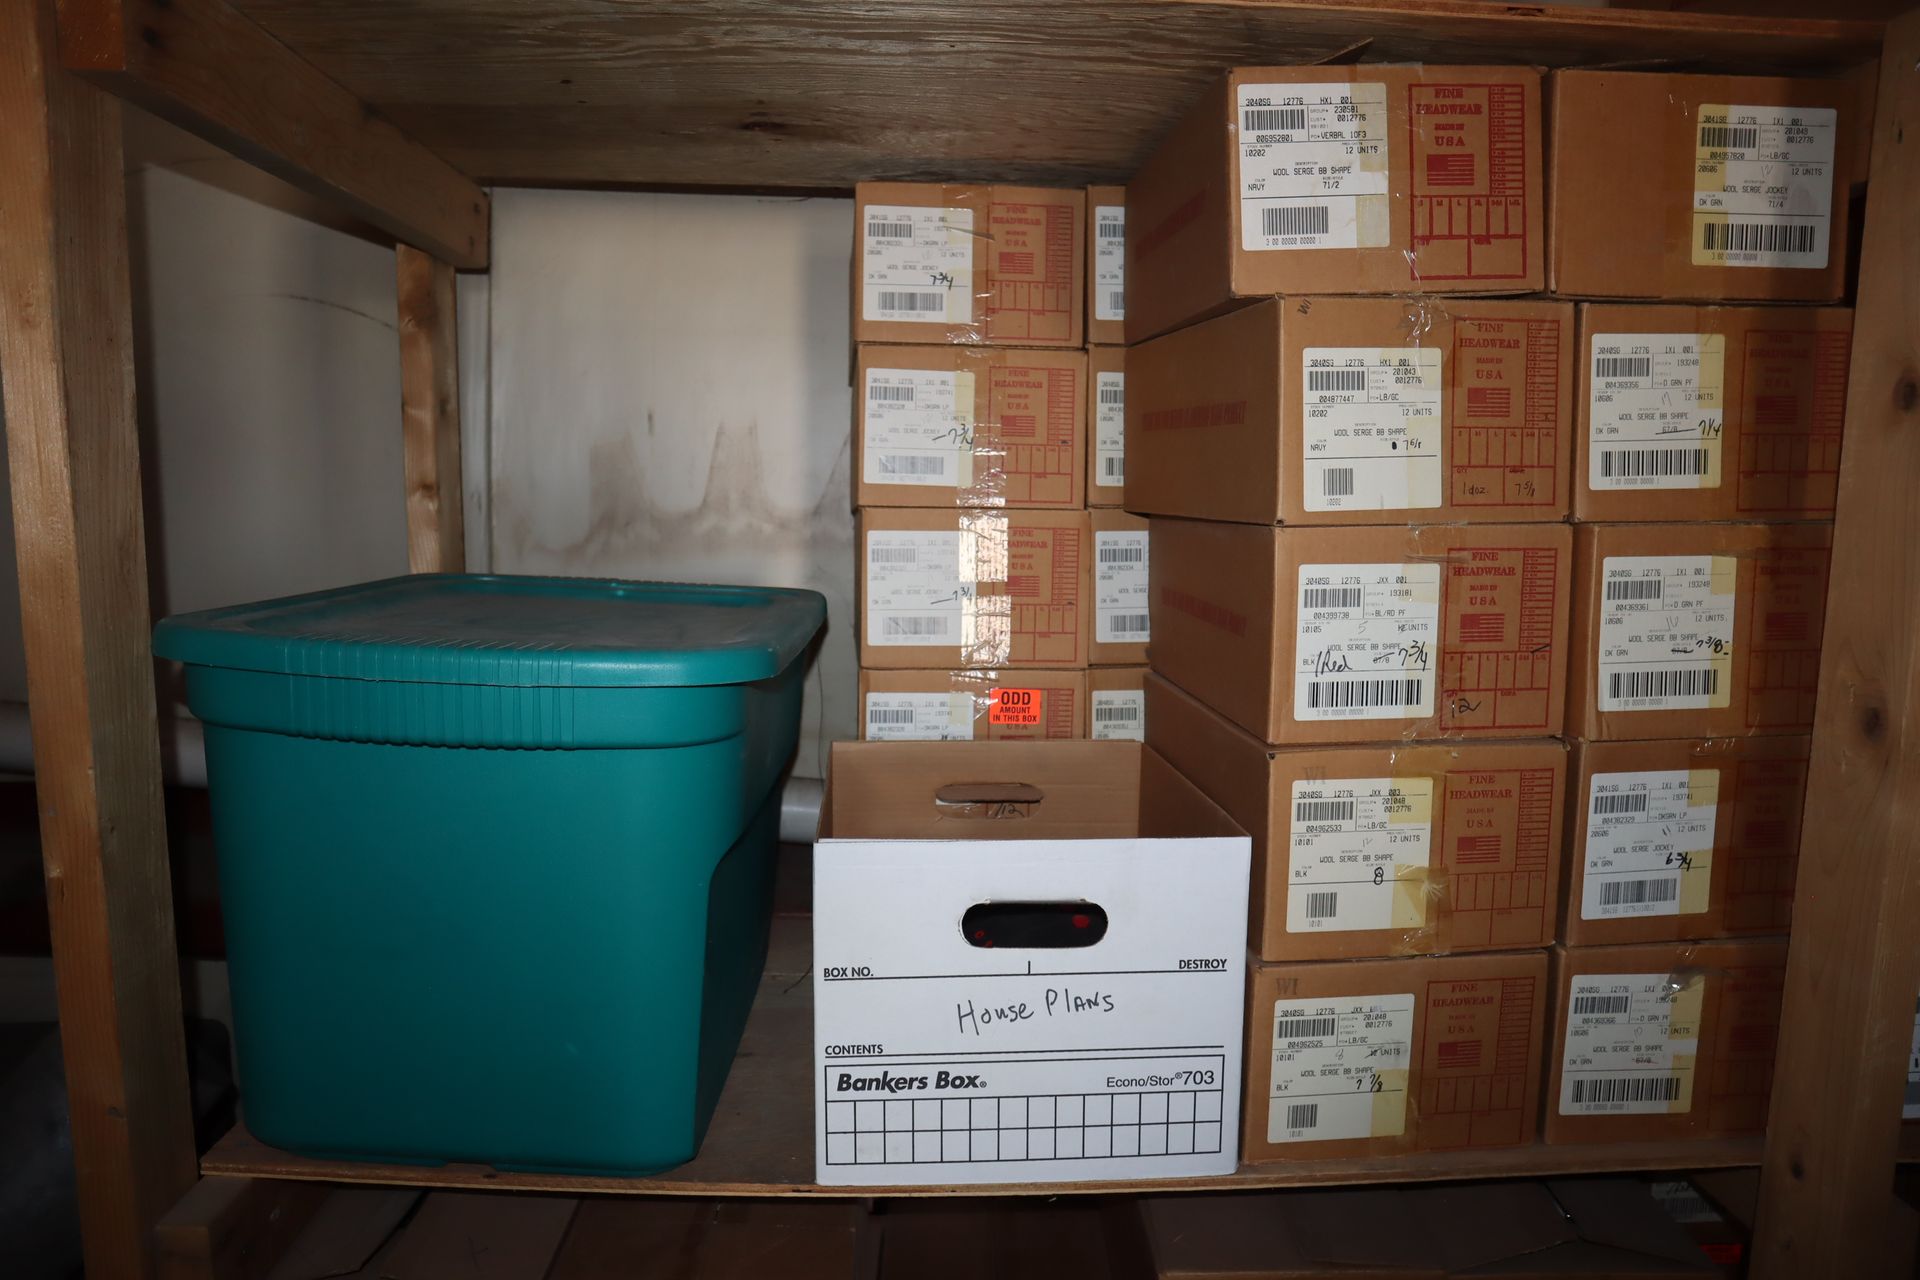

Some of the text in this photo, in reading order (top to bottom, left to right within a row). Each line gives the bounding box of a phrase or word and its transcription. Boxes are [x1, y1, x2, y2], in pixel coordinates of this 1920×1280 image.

[1434, 88, 1464, 99] FINE
[1434, 136, 1465, 147] USA
[1245, 149, 1266, 157] 10202
[1345, 145, 1378, 155] 12 UNITS
[1272, 166, 1352, 176] WOOL SERGE SHAPE
[1791, 168, 1822, 176] 12 UNITS
[1247, 183, 1265, 191] NAVY
[1722, 185, 1738, 193] WOOL
[1742, 185, 1762, 194] SERGE
[1477, 322, 1504, 334] FINE
[1459, 338, 1520, 350] HEADWEAR
[1398, 358, 1410, 367] 001
[1475, 369, 1503, 380] USA
[1684, 392, 1714, 401] 12 UNITS
[1308, 409, 1328, 418] 10202
[1401, 408, 1432, 417] 12 UNITS
[1618, 411, 1688, 420] WOOL SERGE SHAPE
[1334, 428, 1407, 437] WOOL SERGE SHAPE
[1310, 444, 1327, 452] NAVY
[1471, 551, 1498, 562] FINE
[1452, 566, 1516, 577] HEADWEAR
[1395, 576, 1407, 584] 001
[1469, 596, 1497, 606] USA
[1705, 614, 1725, 622] UNITS
[1407, 623, 1428, 631] UNITS
[1628, 633, 1698, 643] WOOL SERGE SHAPE
[1327, 642, 1400, 652] WOOL SERGE SHAPE
[1001, 691, 1031, 705] ODD
[1000, 706, 1031, 714] AMOUNT
[992, 714, 1037, 722] IN THIS BOX
[1469, 775, 1496, 785] FINE
[1450, 788, 1513, 800] HEADWEAR
[1466, 819, 1493, 829] USA
[1677, 824, 1706, 833] 12 UNITS
[1389, 834, 1421, 844] 12 UNITS
[1613, 846, 1628, 854] WOOL
[1631, 845, 1649, 853] SERGE
[1319, 853, 1394, 864] WOOL SERGE SHAPE
[1294, 870, 1307, 878] BLK
[1178, 958, 1228, 971] DESTROY
[823, 966, 875, 979] BOX NO.
[1451, 983, 1479, 993] FINE
[1432, 996, 1494, 1008] HEADWEAR
[956, 999, 1034, 1036] House
[1448, 1025, 1474, 1034] USA
[825, 1043, 884, 1056] CONTENTS
[1380, 1048, 1401, 1056] UNITS
[1300, 1066, 1374, 1078] WOOL SERGE SHAPE
[836, 1070, 929, 1093] Bankers
[1275, 1083, 1289, 1091] BLK
